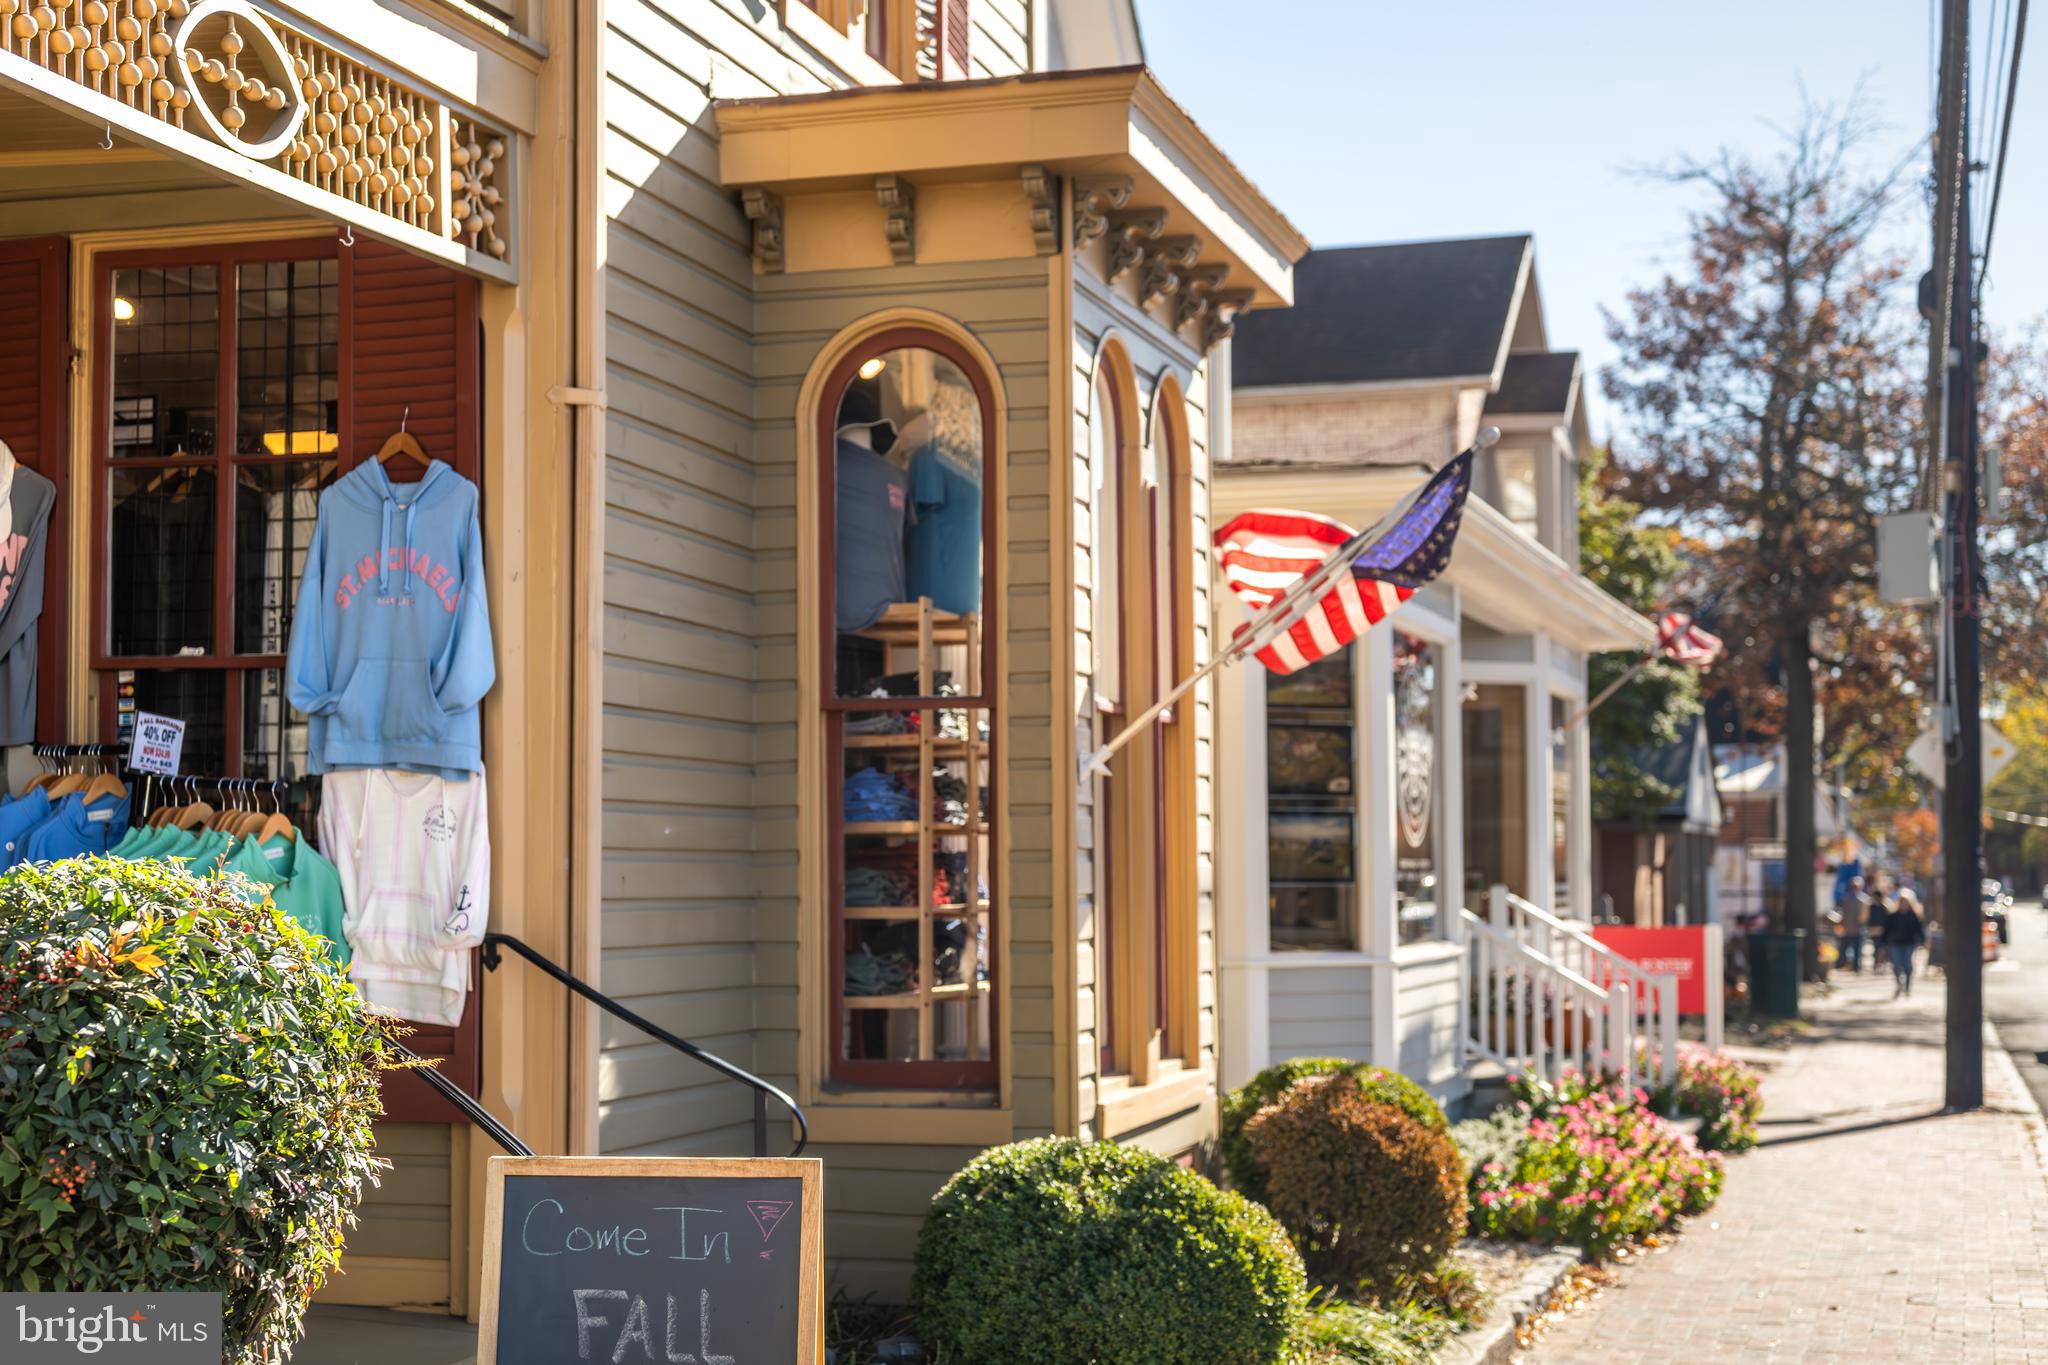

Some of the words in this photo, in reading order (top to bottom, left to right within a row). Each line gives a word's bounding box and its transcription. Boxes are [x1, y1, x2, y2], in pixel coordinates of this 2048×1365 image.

[144, 725, 159, 741] 40%
[161, 729, 176, 744] OFF
[523, 1199, 650, 1256] Come
[652, 1207, 731, 1264] In
[573, 1288, 736, 1365] FALL
